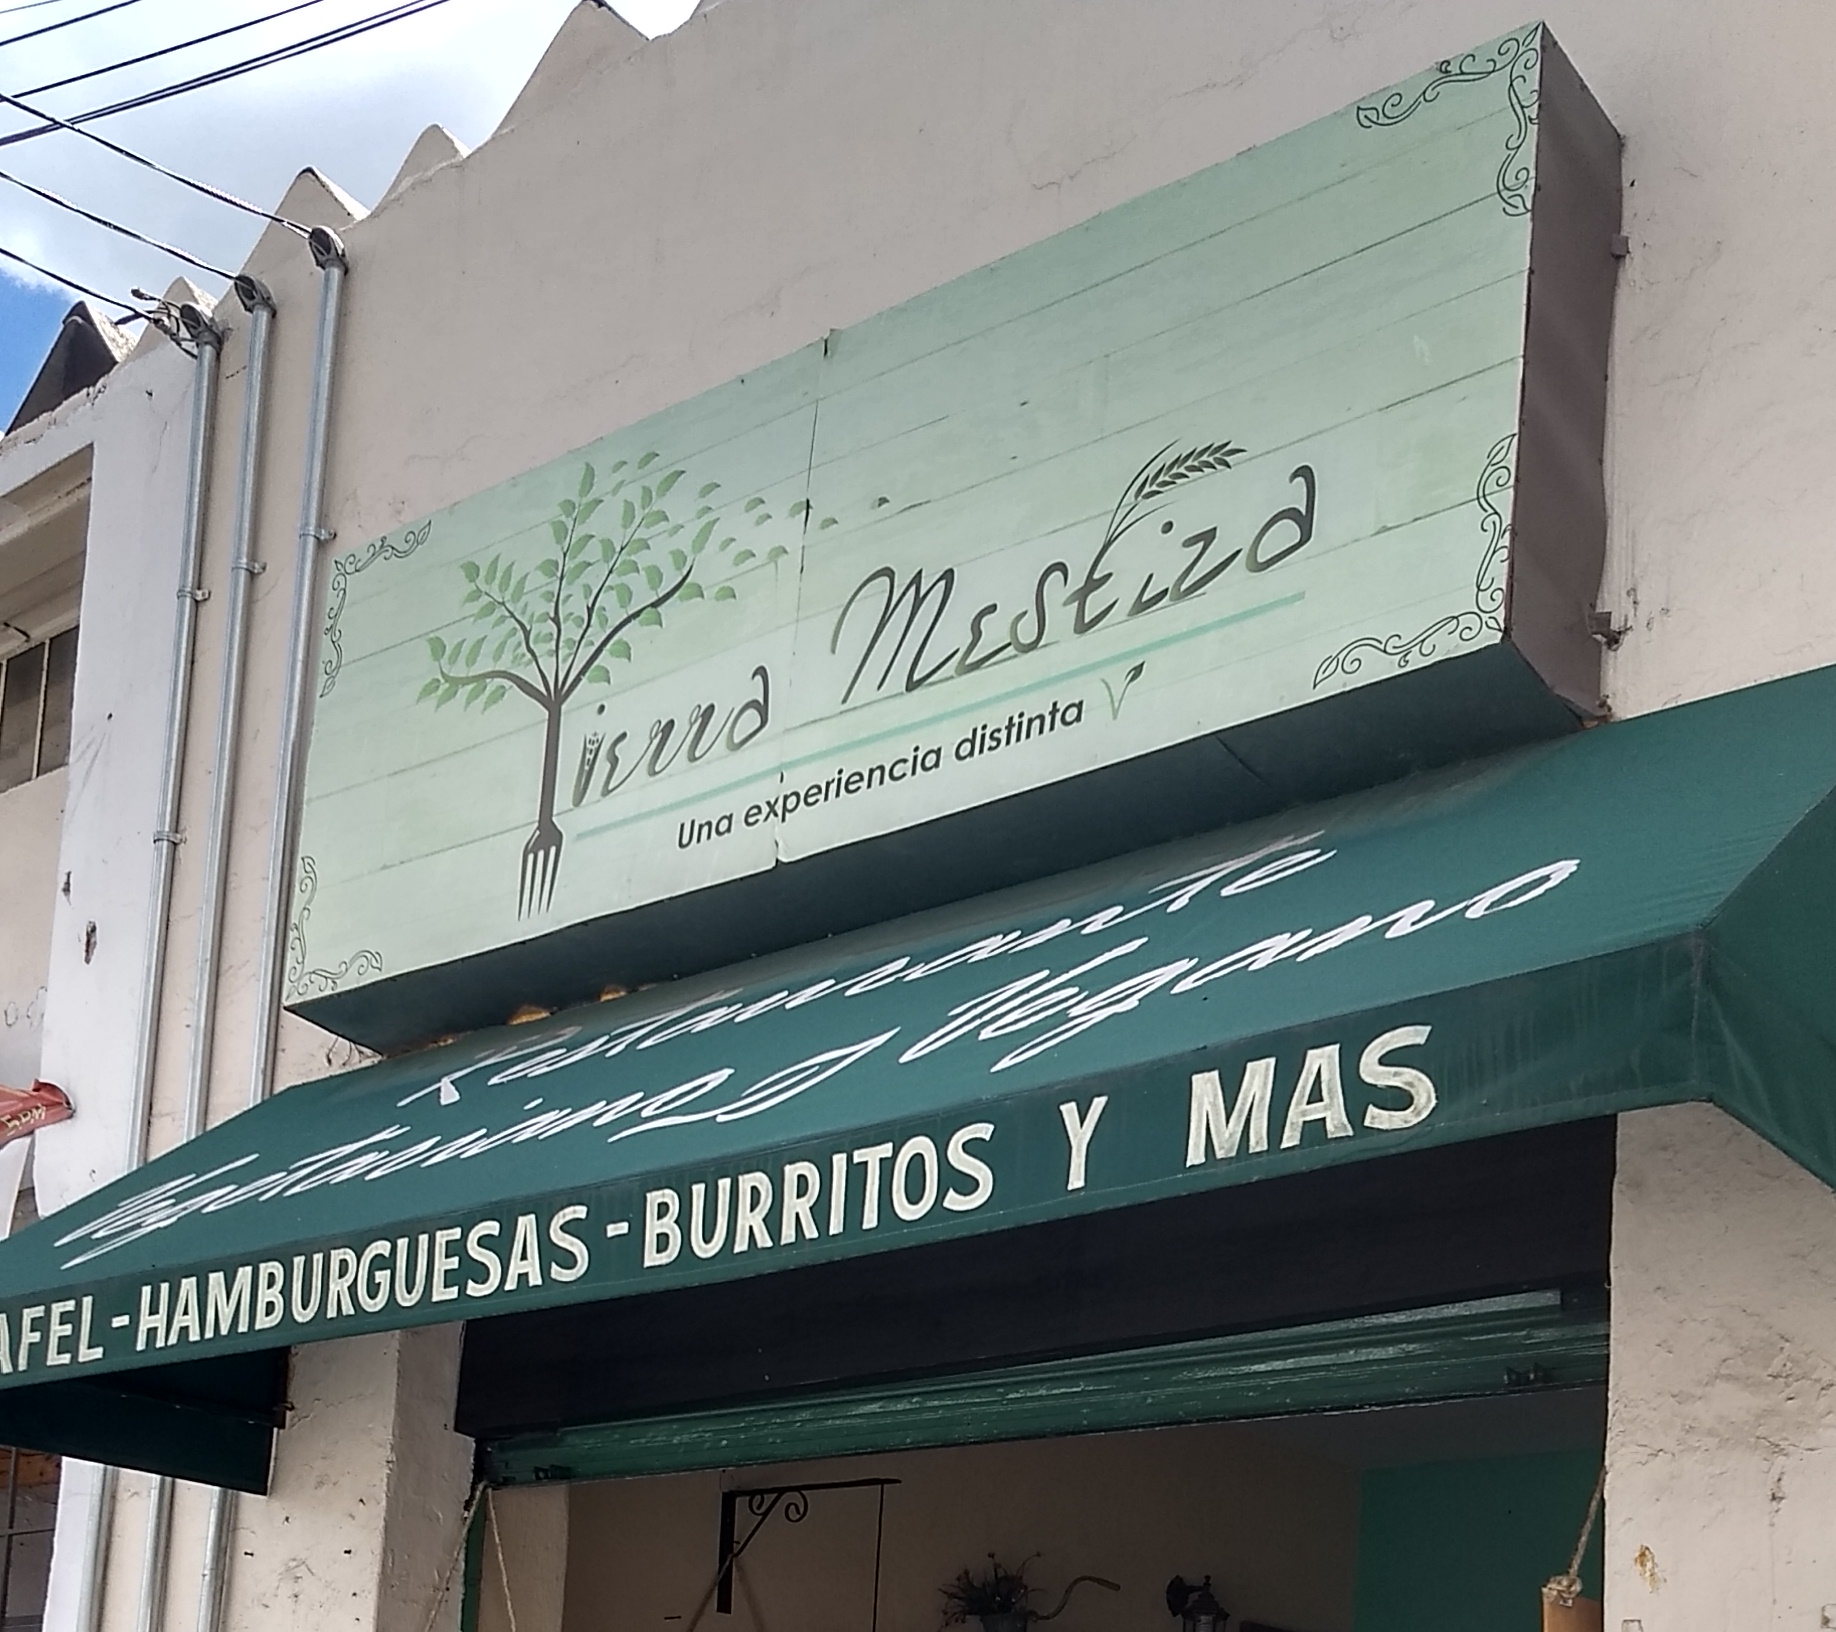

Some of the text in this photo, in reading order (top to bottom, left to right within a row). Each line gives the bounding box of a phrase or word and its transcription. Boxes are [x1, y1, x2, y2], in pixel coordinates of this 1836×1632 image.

[676, 699, 1085, 850] Una experiencia distinta
[898, 857, 1581, 1073] Vegano
[136, 1203, 590, 1351] HAMBURGUESAS
[643, 1121, 995, 1269] BURRITOS
[1058, 1094, 1109, 1191] Y
[1185, 1024, 1438, 1168] MAS
